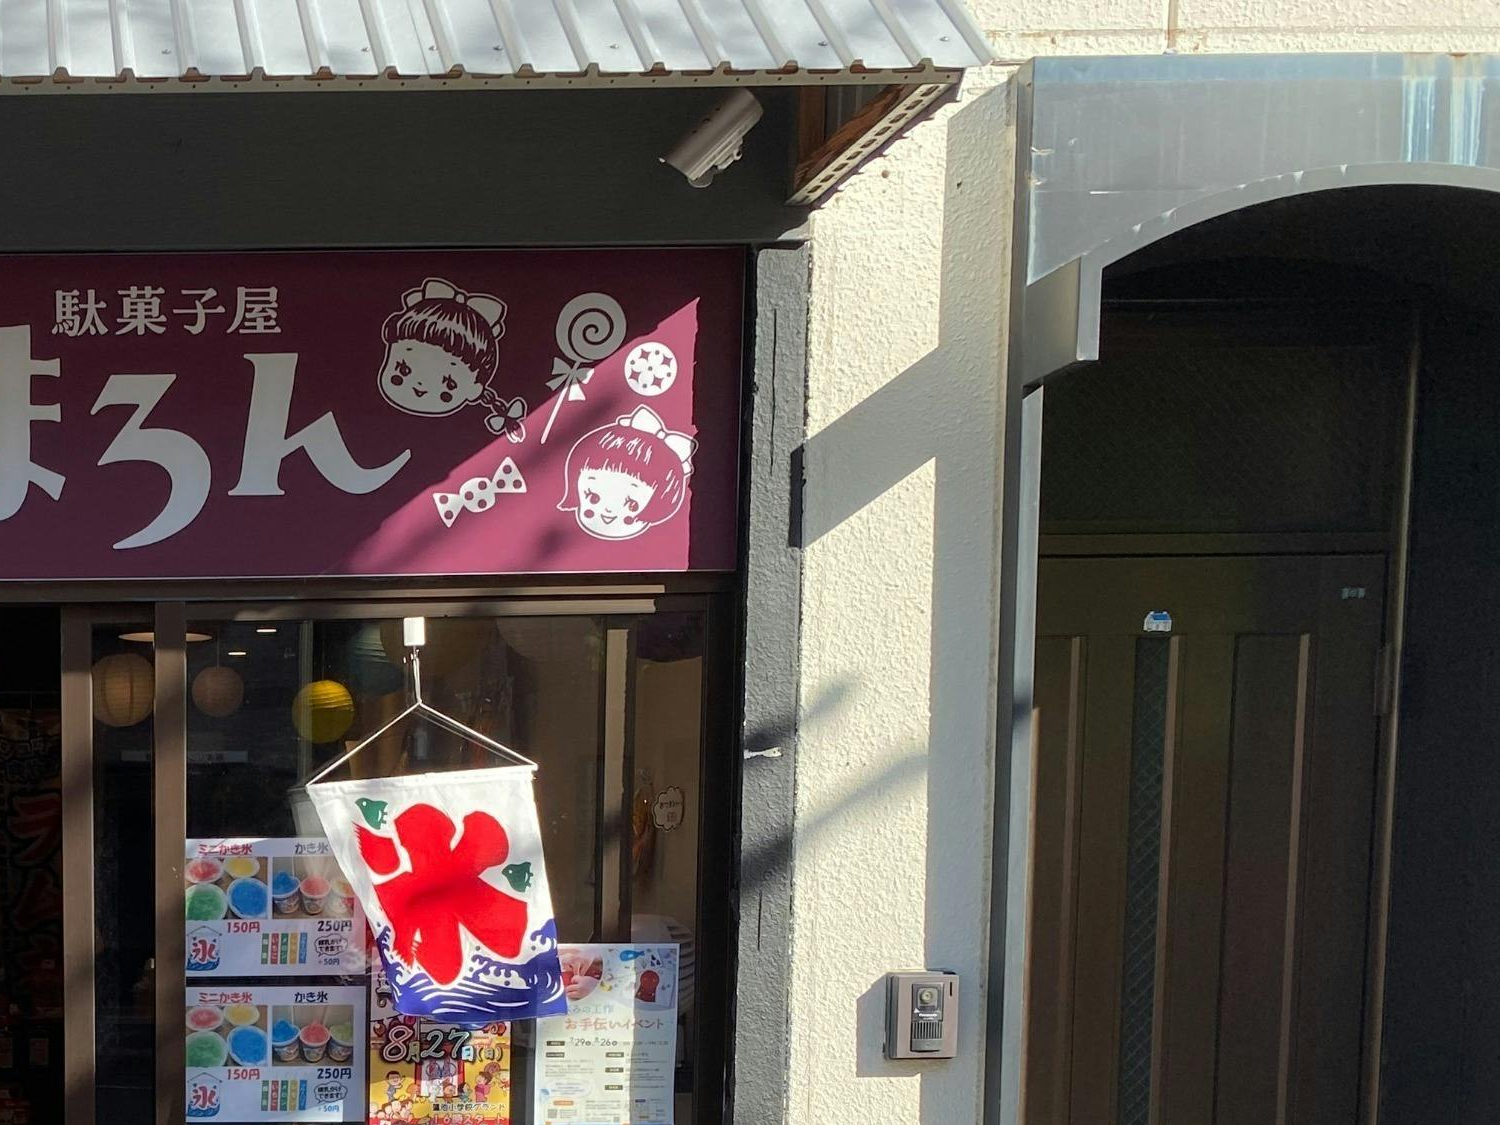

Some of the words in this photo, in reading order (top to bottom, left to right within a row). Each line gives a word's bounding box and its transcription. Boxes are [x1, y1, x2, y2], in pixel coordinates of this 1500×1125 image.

[52, 285, 283, 337] 駄菓子屋
[198, 843, 253, 856] ミニかき氷
[294, 842, 329, 855] かき氷
[227, 921, 261, 933] 150円
[317, 920, 353, 932] 250円
[198, 991, 253, 1004] ミニかき氷
[294, 991, 329, 1003] かき氷
[565, 1017, 664, 1031] お手伝いイベント
[227, 1068, 261, 1081] 150円
[317, 1067, 352, 1080] 250円
